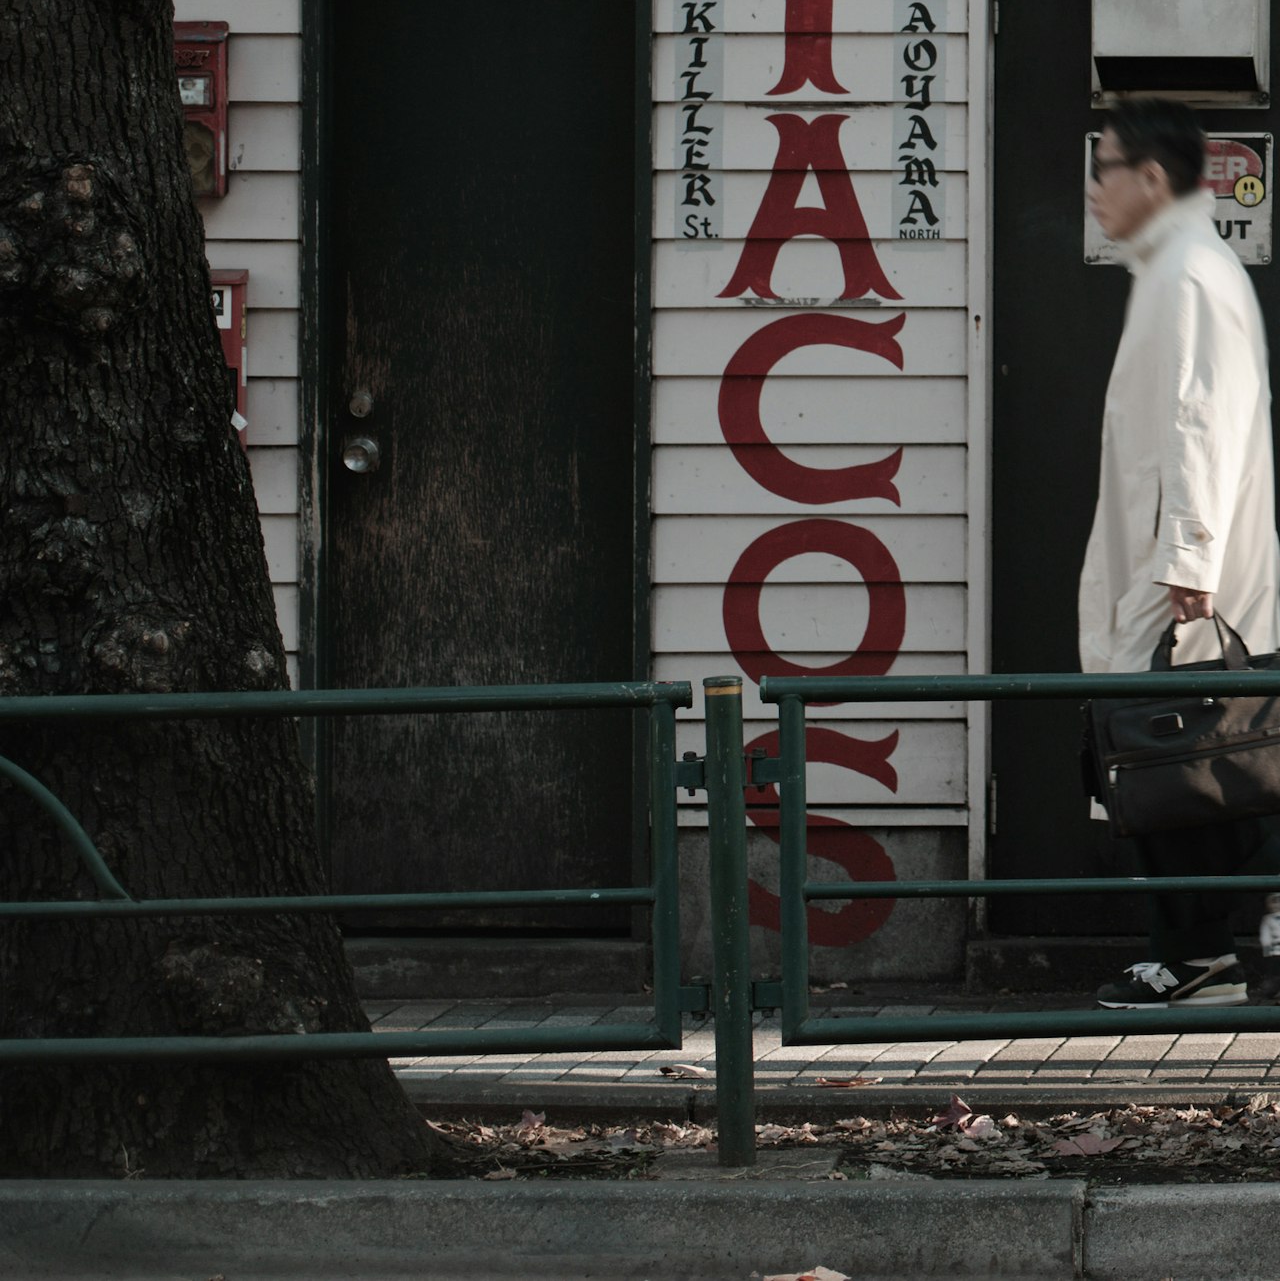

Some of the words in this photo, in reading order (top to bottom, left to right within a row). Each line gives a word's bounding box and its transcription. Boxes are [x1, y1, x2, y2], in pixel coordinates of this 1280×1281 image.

[681, 2, 717, 207] KILLER
[899, 3, 940, 227] AOYAMA
[683, 214, 719, 239] St.
[900, 228, 940, 240] NORTH
[1217, 220, 1252, 240] UT
